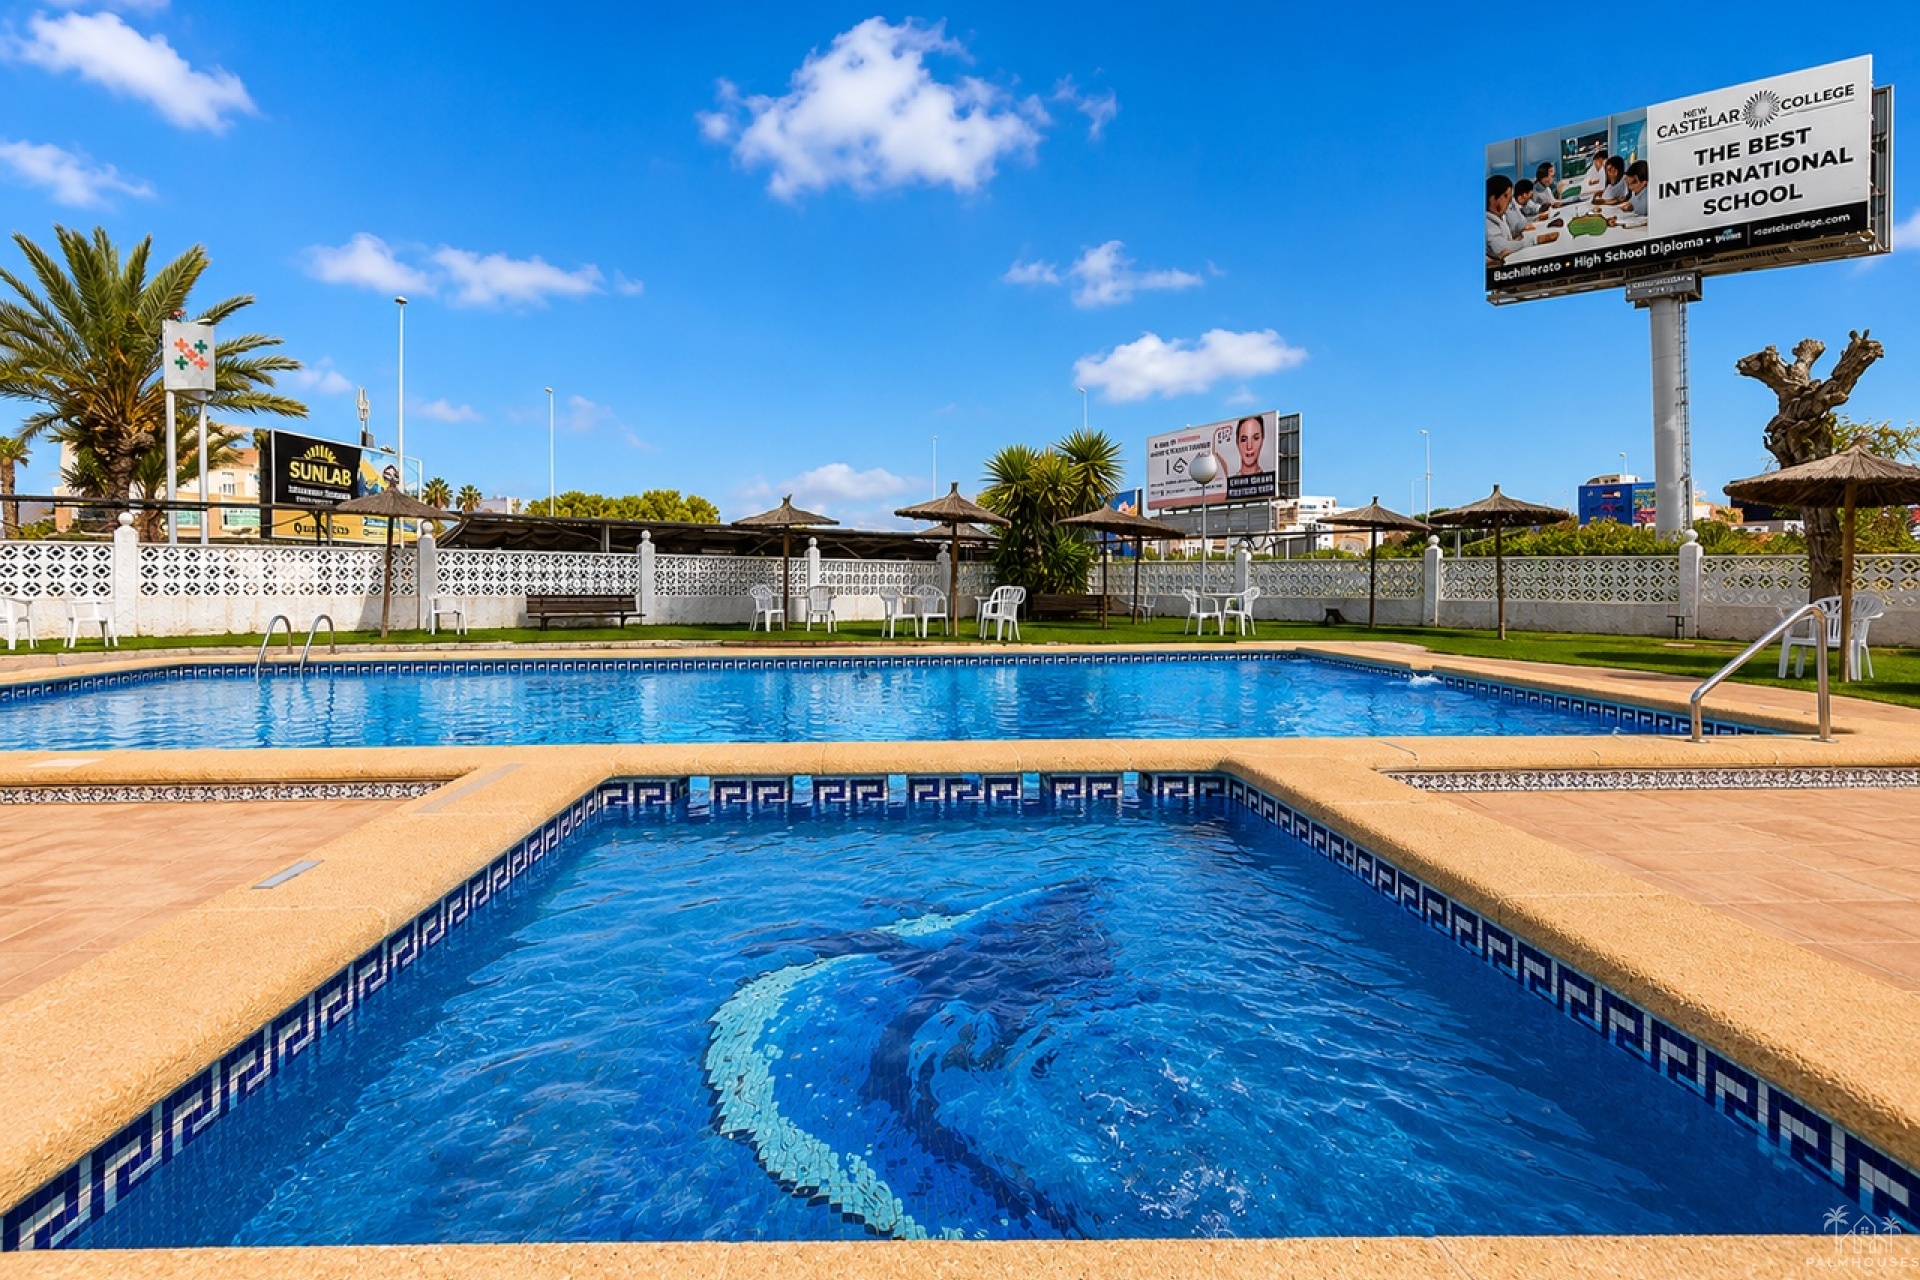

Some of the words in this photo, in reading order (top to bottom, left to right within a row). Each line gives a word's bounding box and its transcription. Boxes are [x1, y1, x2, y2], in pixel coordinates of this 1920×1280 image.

[1656, 108, 1740, 139] CASTELAR
[1780, 83, 1855, 110] COLLEGE
[1683, 106, 1708, 119] NEW
[1693, 141, 1741, 167] THE
[1748, 127, 1812, 155] BEST
[1658, 147, 1854, 200] INTERNATIONAL
[1703, 183, 1803, 215] SCHOOL
[1493, 262, 1563, 281] Bachillerato
[1574, 253, 1601, 268] High
[1605, 246, 1647, 263] School
[1650, 237, 1704, 256] Diploma
[289, 461, 352, 487] SUNLAB
